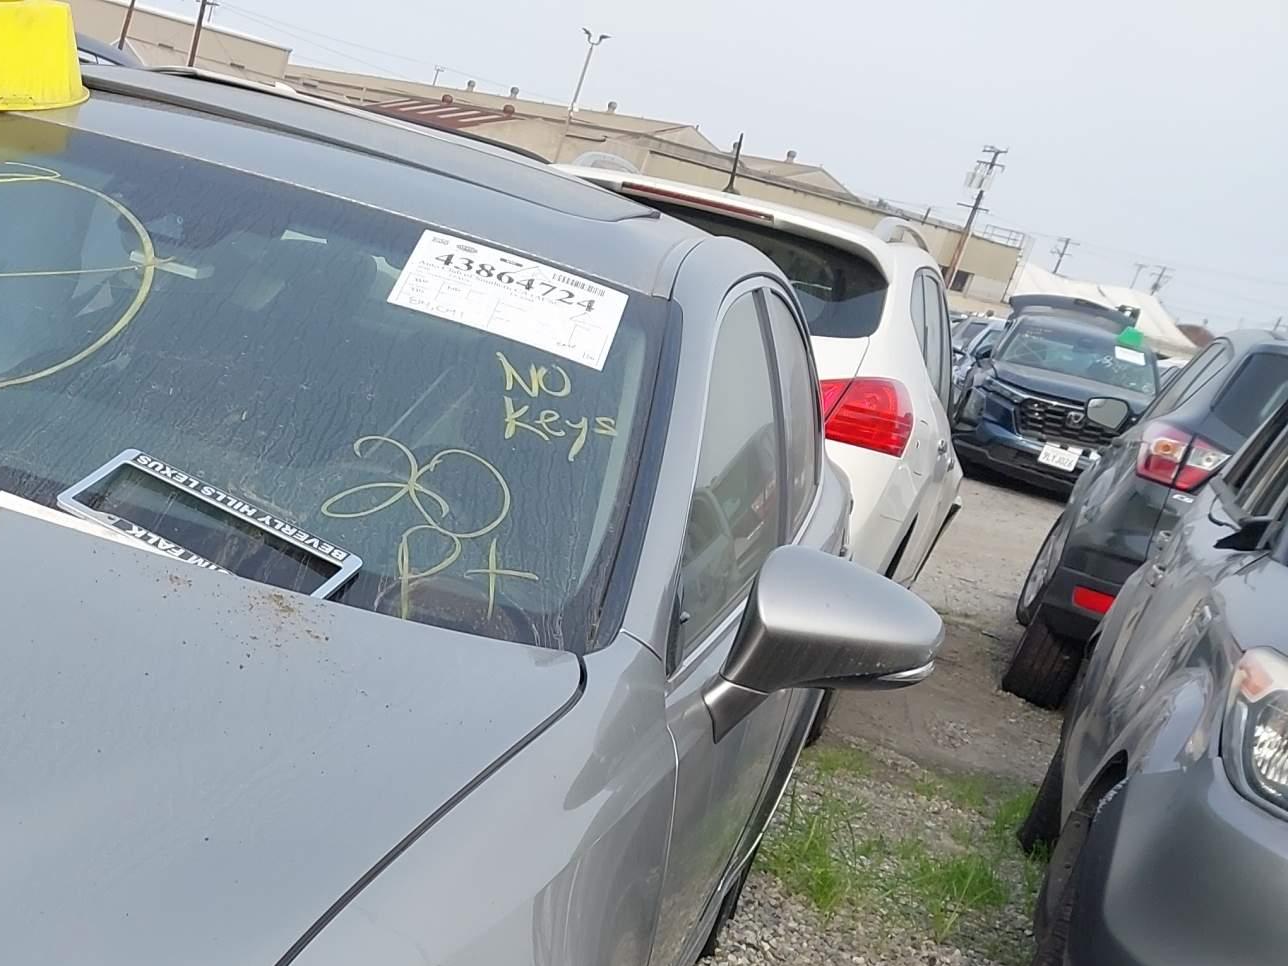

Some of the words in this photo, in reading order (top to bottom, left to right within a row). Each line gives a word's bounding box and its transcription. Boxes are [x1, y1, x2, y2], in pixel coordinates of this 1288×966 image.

[434, 253, 596, 312] 43864724
[496, 351, 572, 398] NO
[135, 454, 198, 490] LEXUS
[200, 485, 257, 515] HILLS
[124, 525, 190, 559] FALK
[258, 509, 350, 560] BEVERLY
